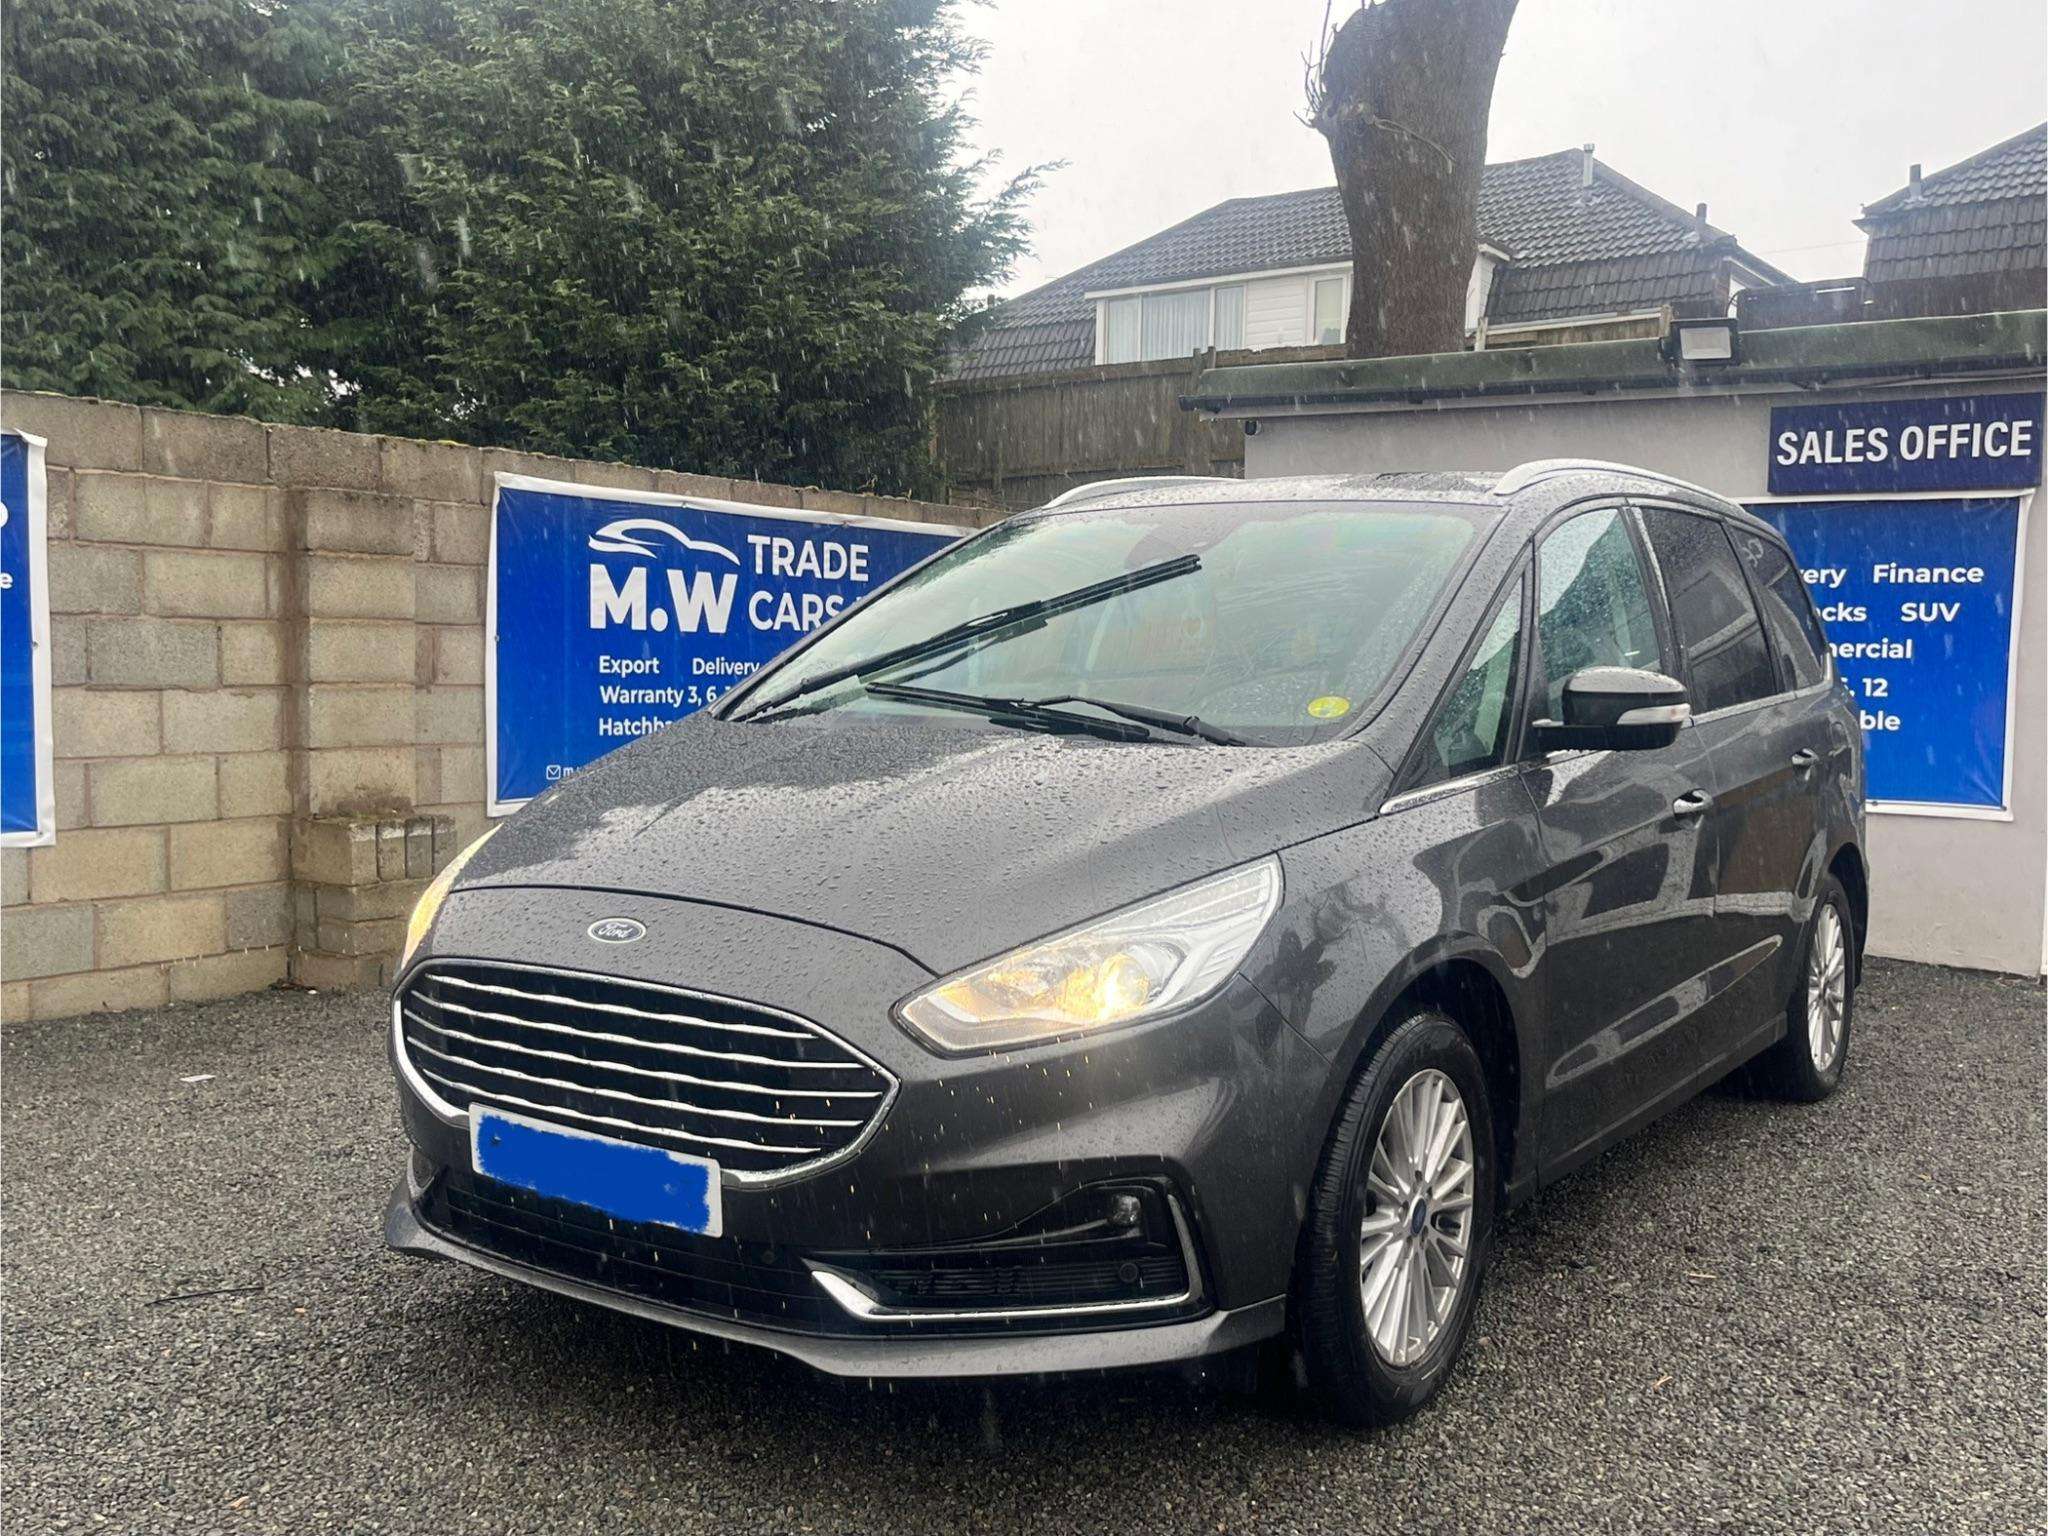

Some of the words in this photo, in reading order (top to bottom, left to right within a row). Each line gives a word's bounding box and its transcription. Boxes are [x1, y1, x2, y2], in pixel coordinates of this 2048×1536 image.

[1777, 427, 1889, 465] SALES
[1900, 420, 2033, 461] OFFICE
[747, 534, 870, 582] TRADE
[1800, 568, 1847, 589] ery
[1873, 562, 1985, 584] Finance
[589, 563, 739, 634] M.W
[748, 590, 844, 632] CARS
[1815, 602, 1868, 622] cks
[1900, 602, 1961, 622] SUV
[599, 655, 660, 678] Export
[692, 657, 760, 676] Delivery
[600, 685, 684, 708] Warranty
[687, 686, 702, 707] 3,
[1862, 677, 1889, 698] 12
